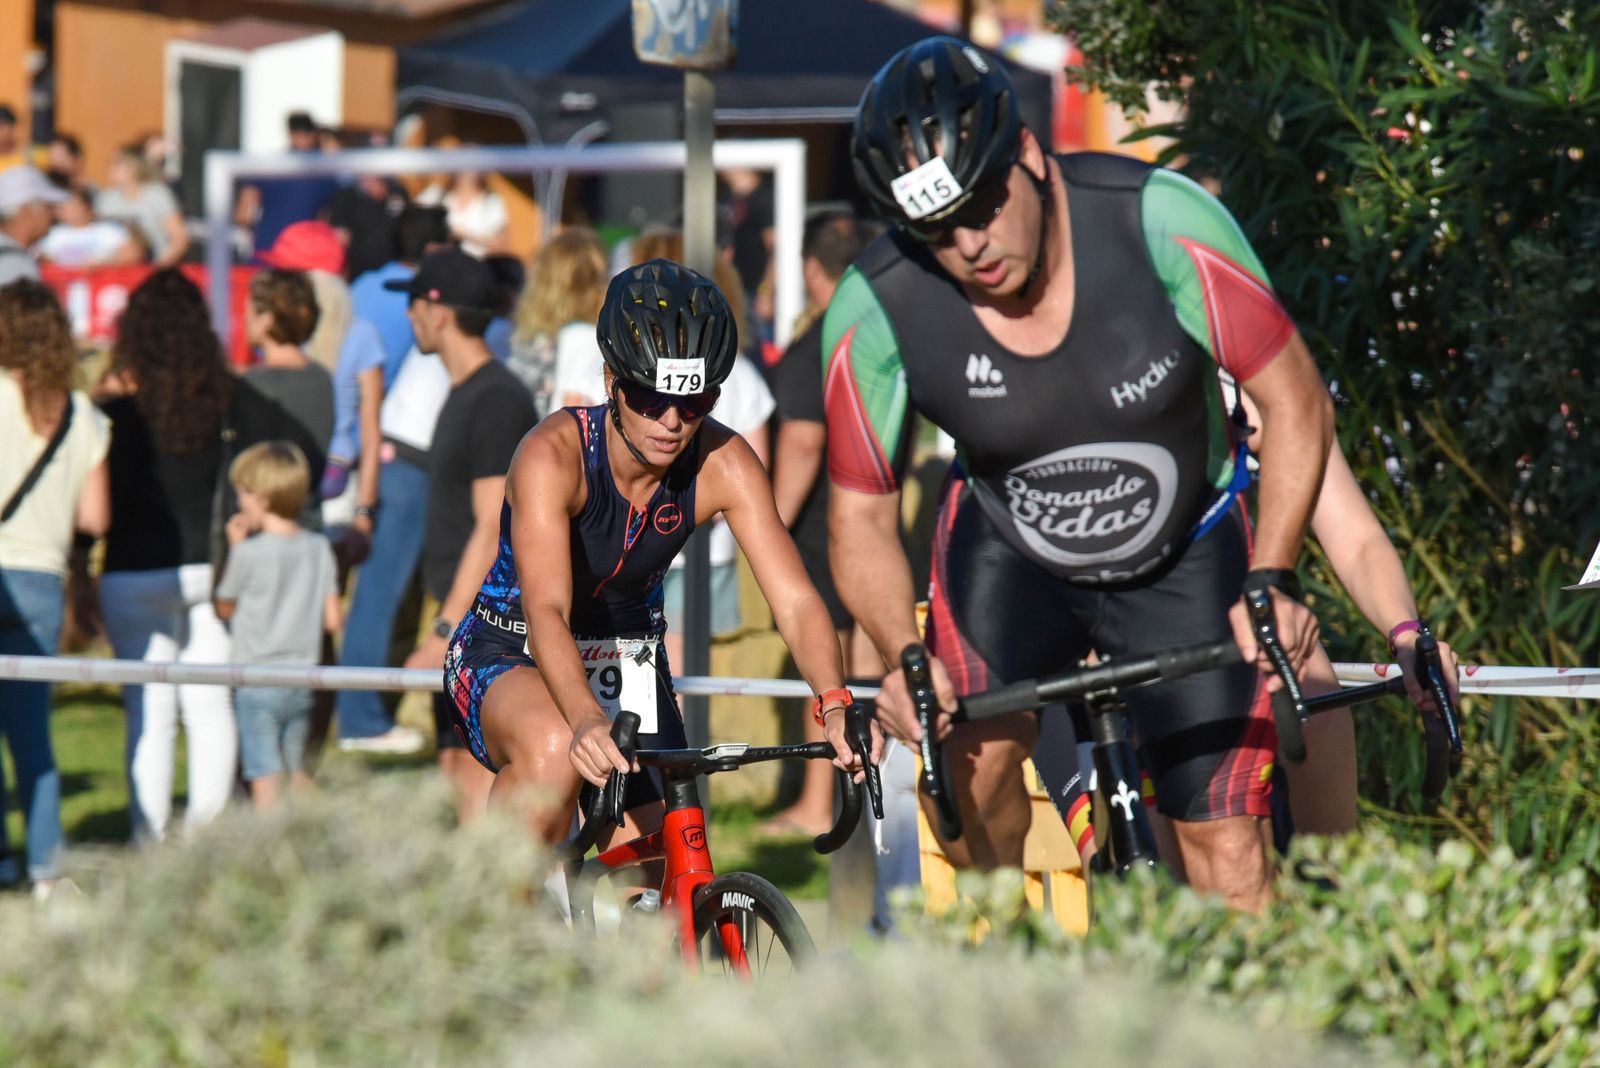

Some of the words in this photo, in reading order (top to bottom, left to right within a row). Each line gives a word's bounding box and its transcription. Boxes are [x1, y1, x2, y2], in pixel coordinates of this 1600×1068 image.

[907, 177, 952, 212] 115
[662, 373, 702, 392] 179
[476, 603, 527, 634] HUUB
[722, 892, 755, 911] MAVIC
